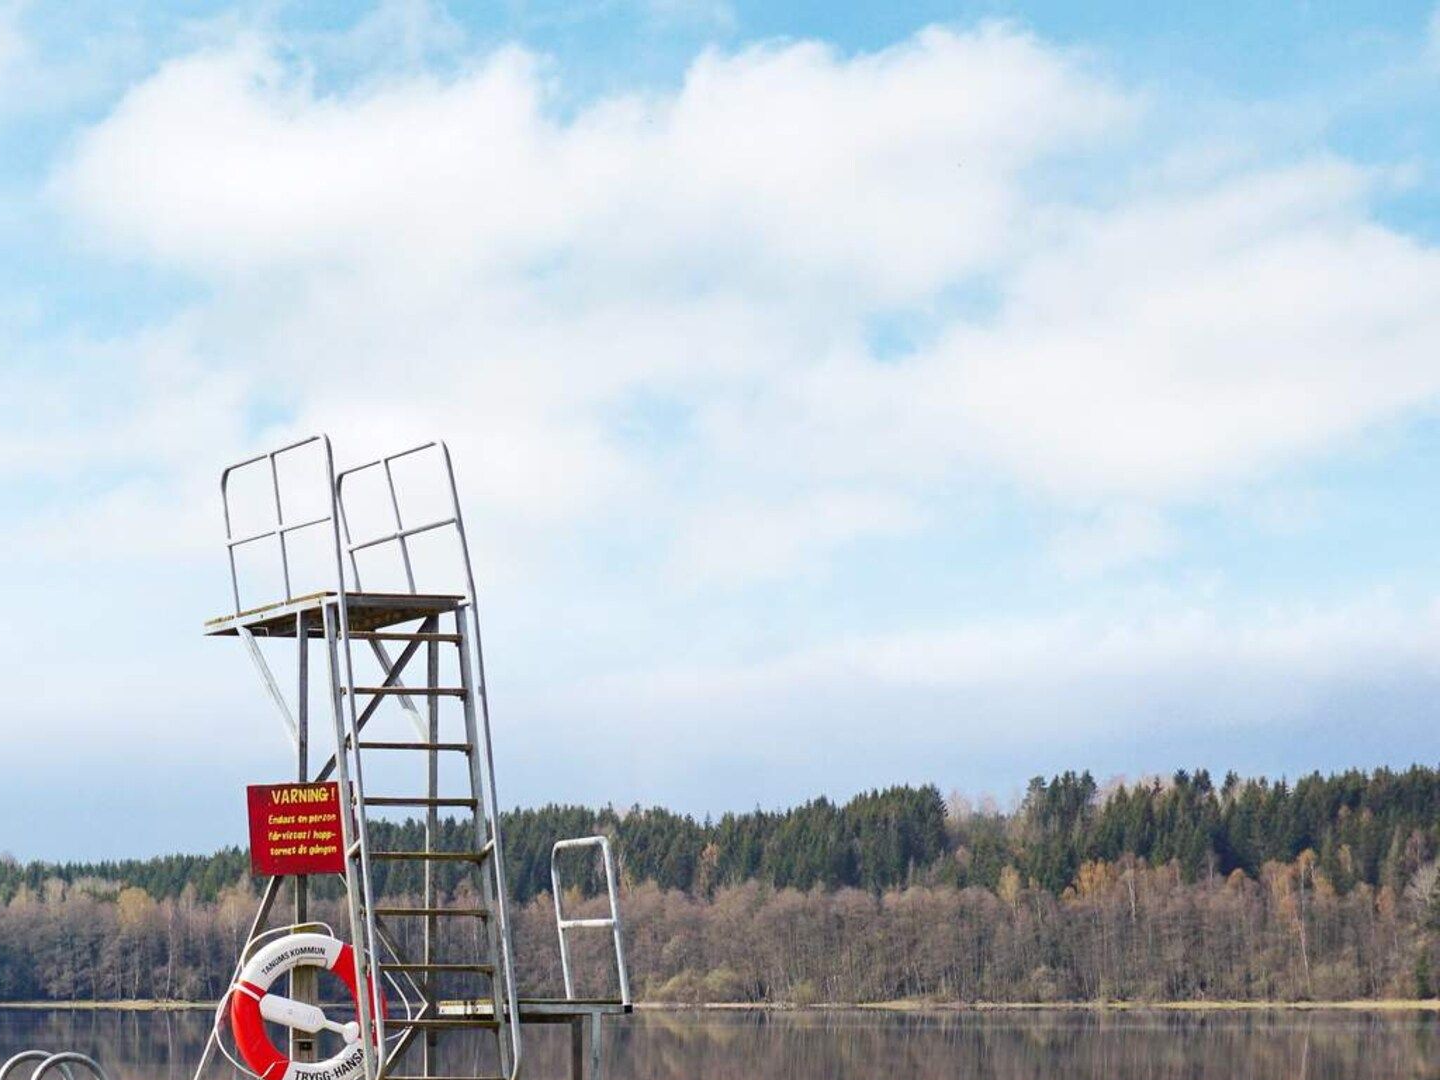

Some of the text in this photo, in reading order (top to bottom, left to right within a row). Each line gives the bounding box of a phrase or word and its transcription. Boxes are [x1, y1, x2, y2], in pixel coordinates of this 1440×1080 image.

[268, 813, 337, 825] Endast en person
[282, 830, 307, 840] vistas
[270, 846, 296, 856] tornet
[309, 844, 337, 856] gången
[289, 946, 326, 958] KOMMUN
